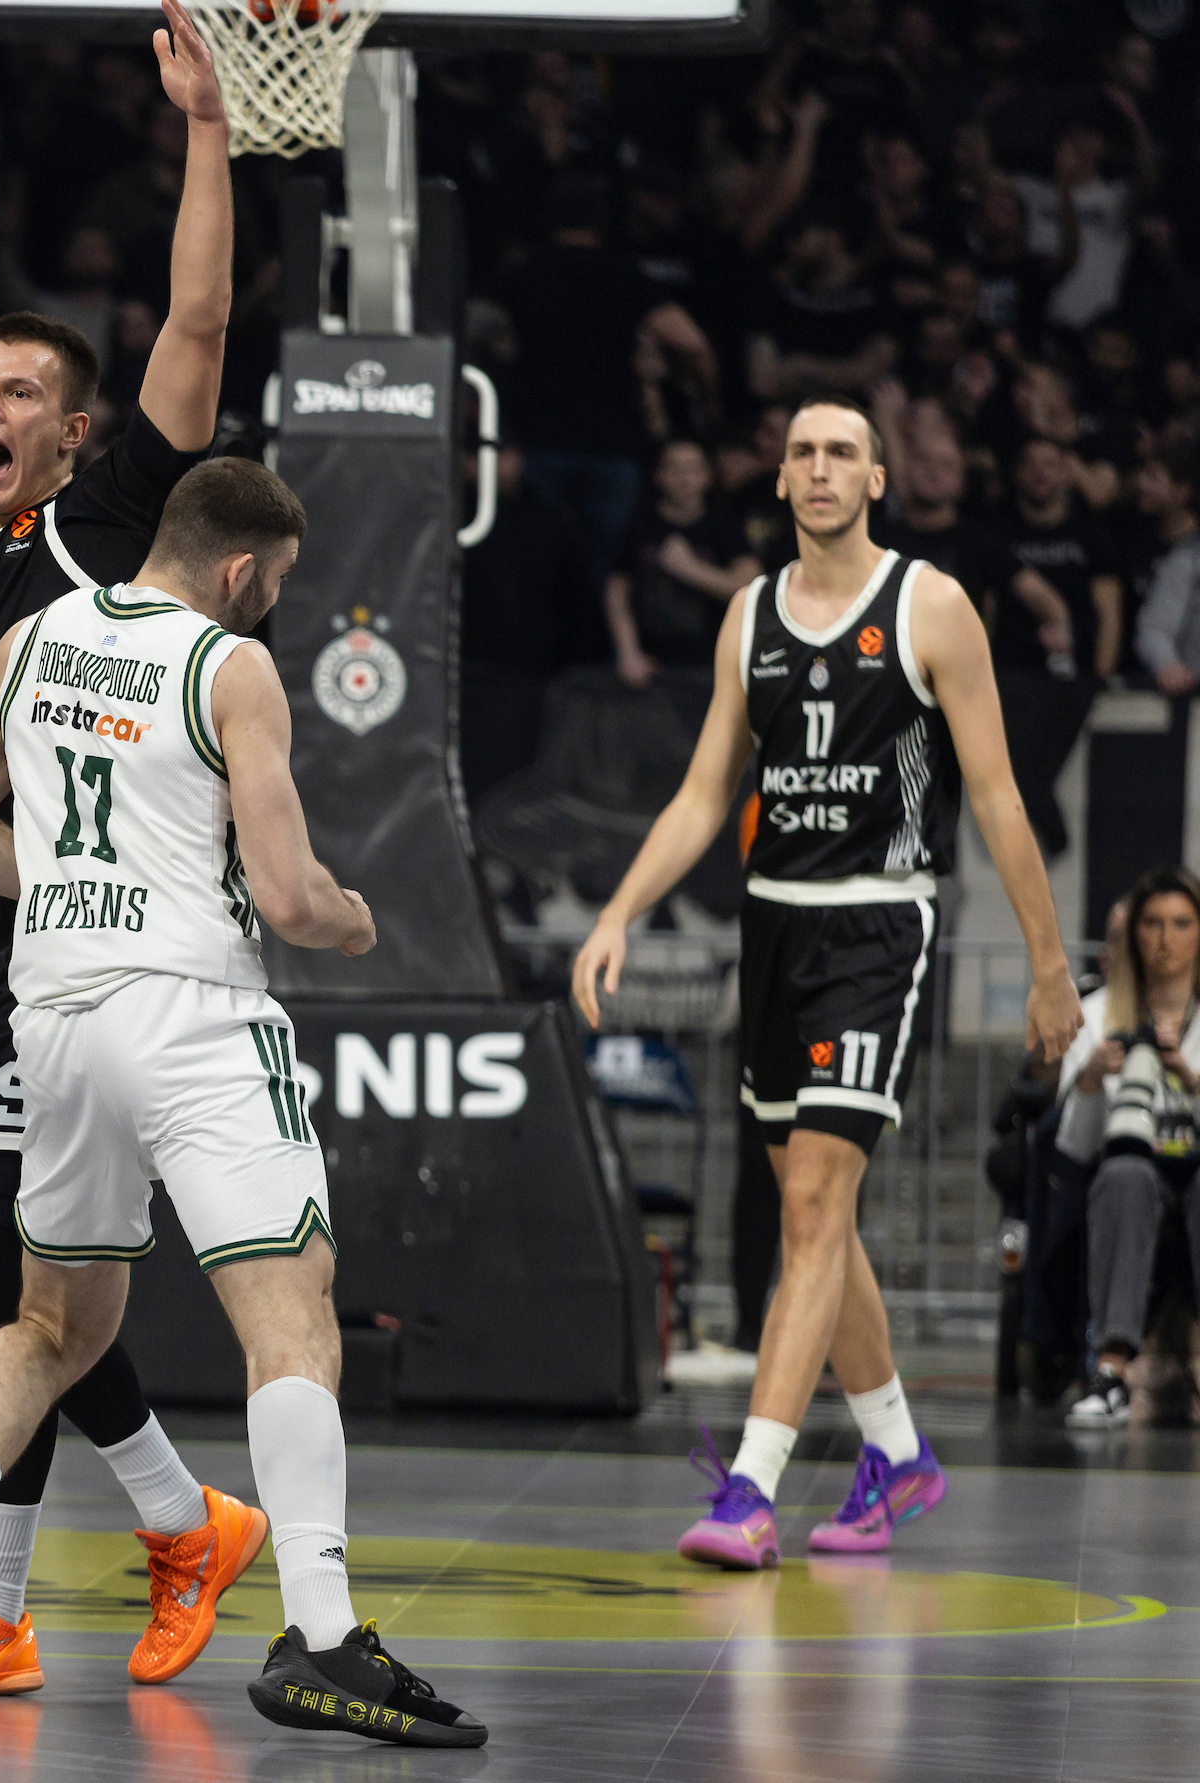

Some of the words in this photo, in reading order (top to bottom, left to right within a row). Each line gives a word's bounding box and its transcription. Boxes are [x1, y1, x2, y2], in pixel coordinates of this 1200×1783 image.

[31, 691, 152, 744] instacar
[802, 700, 835, 760] 11
[55, 746, 117, 864] 17
[25, 880, 148, 935] ATHENS
[334, 1031, 529, 1120] NIS
[841, 1029, 881, 1090] 11
[284, 1684, 339, 1716] THE
[346, 1701, 417, 1733] CITY
